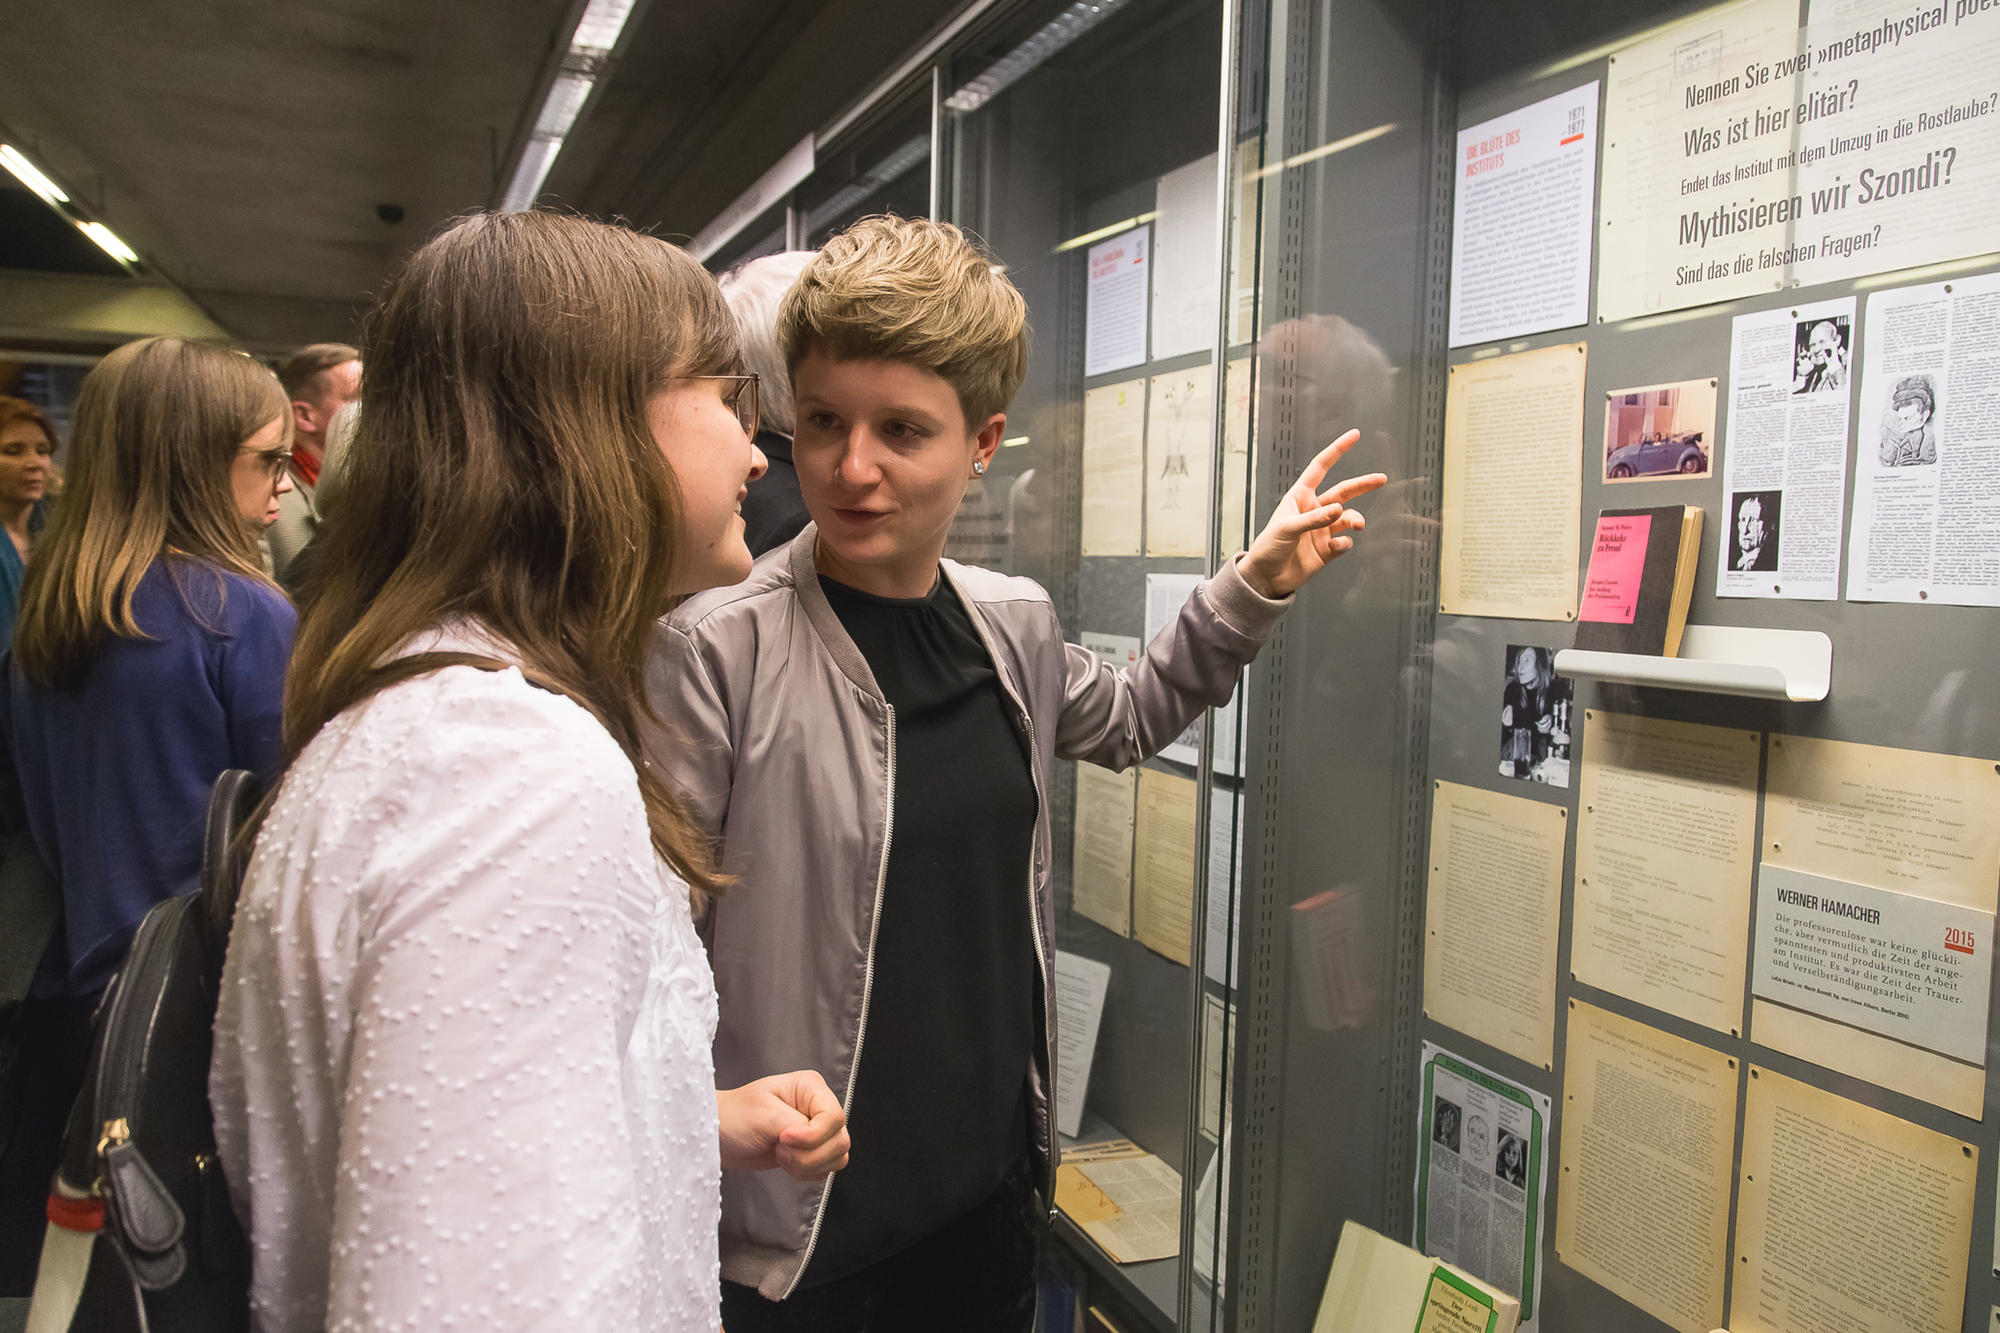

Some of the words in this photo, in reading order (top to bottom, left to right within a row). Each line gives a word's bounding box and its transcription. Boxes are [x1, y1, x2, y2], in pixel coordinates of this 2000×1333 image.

[1686, 75, 1740, 109] Nennen
[1745, 63, 1769, 89] Sie
[1775, 45, 1812, 80] zwei
[1817, 0, 1948, 64] »metaphysical
[1506, 129, 1520, 146] DES
[1681, 174, 1709, 195] Endet
[1712, 169, 1731, 189] das
[1734, 159, 1773, 183] Institut
[1777, 149, 1796, 171] mit
[1800, 142, 1825, 165] dem
[1830, 132, 1871, 157] Umzug
[1876, 126, 1888, 145] in
[1893, 120, 1913, 140] die
[1917, 92, 1999, 132] Rostlaube?
[1683, 126, 1721, 157] Was
[1727, 117, 1748, 145] ist
[1755, 105, 1790, 137] hier
[1796, 79, 1859, 125] elitär?
[1679, 193, 1802, 247] Mythisieren
[1811, 176, 1850, 215] wir
[1858, 147, 1957, 204] Szondi?
[1676, 263, 1703, 286] Sind
[1707, 258, 1729, 284] das
[1733, 252, 1753, 275] die
[1759, 240, 1816, 270] falschen
[1821, 224, 1882, 257] Fragen?
[1777, 888, 1818, 910] WERNER
[1821, 898, 1880, 925] HAMACHER
[1774, 936, 1828, 956] spanntesten
[1831, 950, 1849, 962] und
[1853, 957, 1921, 981] produktivsten
[1924, 975, 1957, 990] Arbeit
[1775, 924, 1793, 937] che,
[1795, 929, 1814, 940] aber
[1818, 936, 1869, 955] vermutlich
[1871, 948, 1887, 959] die
[1891, 952, 1910, 965] Zeit
[1914, 959, 1931, 971] der
[1934, 966, 1963, 980] ange-
[1776, 913, 1790, 922] Die
[1793, 916, 1866, 942] professorenlose
[1870, 937, 1887, 947] war
[1890, 939, 1918, 955] keine
[1921, 950, 1961, 966] glückli-
[1945, 927, 1975, 948] 2015
[1773, 948, 1787, 956] am
[1789, 950, 1826, 967] Institut.
[1830, 961, 1840, 970] Es
[1843, 965, 1860, 976] war
[1863, 968, 1878, 981] die
[1882, 974, 1902, 987] Zeit
[1905, 981, 1923, 994] der
[1926, 986, 1964, 1005] Trauer-
[1773, 957, 1789, 968] und
[1793, 963, 1916, 1005] Verselbständigungsarbeit.
